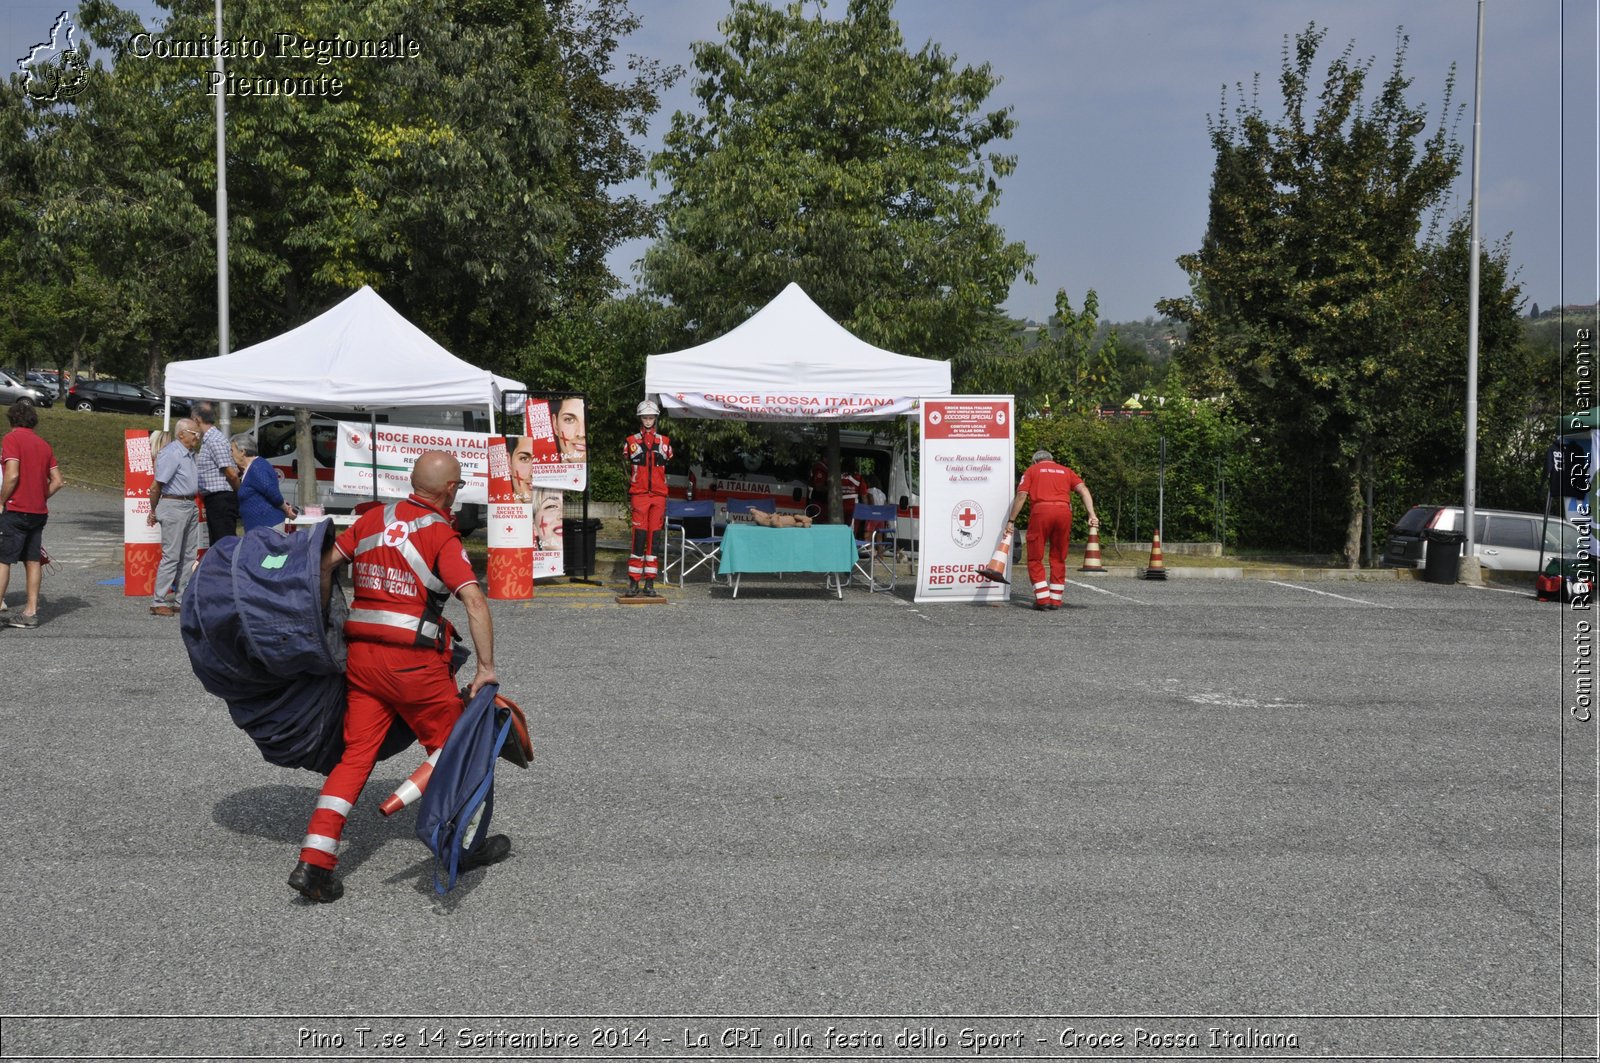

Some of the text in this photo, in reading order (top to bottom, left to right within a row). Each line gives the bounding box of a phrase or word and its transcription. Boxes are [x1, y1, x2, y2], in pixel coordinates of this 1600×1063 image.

[704, 393, 894, 407] CROCE ROSSA ITALIANA
[412, 434, 452, 447] ROSSA
[358, 470, 382, 478] Croe
[726, 482, 770, 494] ITALIANA
[930, 564, 974, 574] RESCUE
[929, 575, 954, 584] RED
[383, 579, 418, 596] SPECIALI
